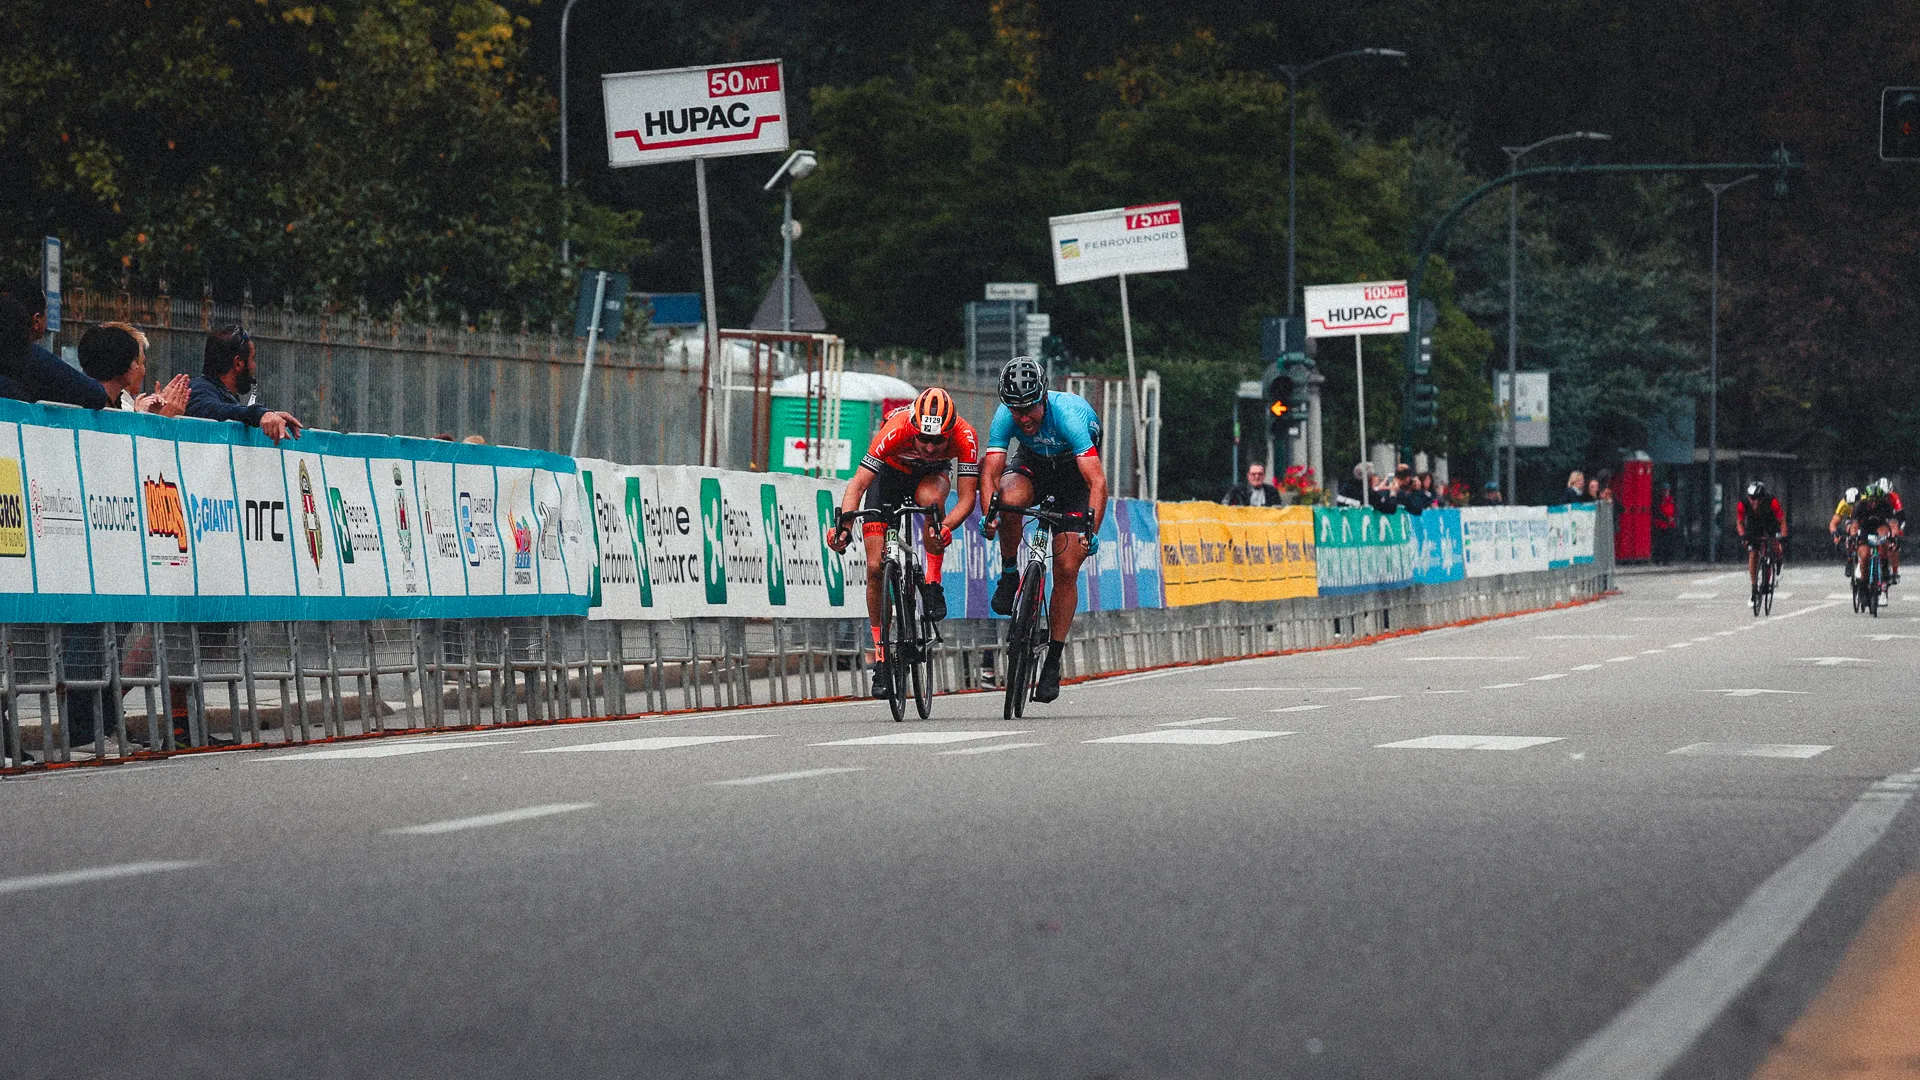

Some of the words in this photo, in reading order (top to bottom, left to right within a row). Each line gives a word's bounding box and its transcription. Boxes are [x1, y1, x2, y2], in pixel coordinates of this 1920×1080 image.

[644, 102, 750, 136] HUPAC
[1084, 230, 1178, 250] FERROVIENORD
[1328, 305, 1388, 322] HUPAC
[924, 416, 941, 424] 2129
[201, 497, 234, 532] GIANT
[246, 500, 284, 541] nrc
